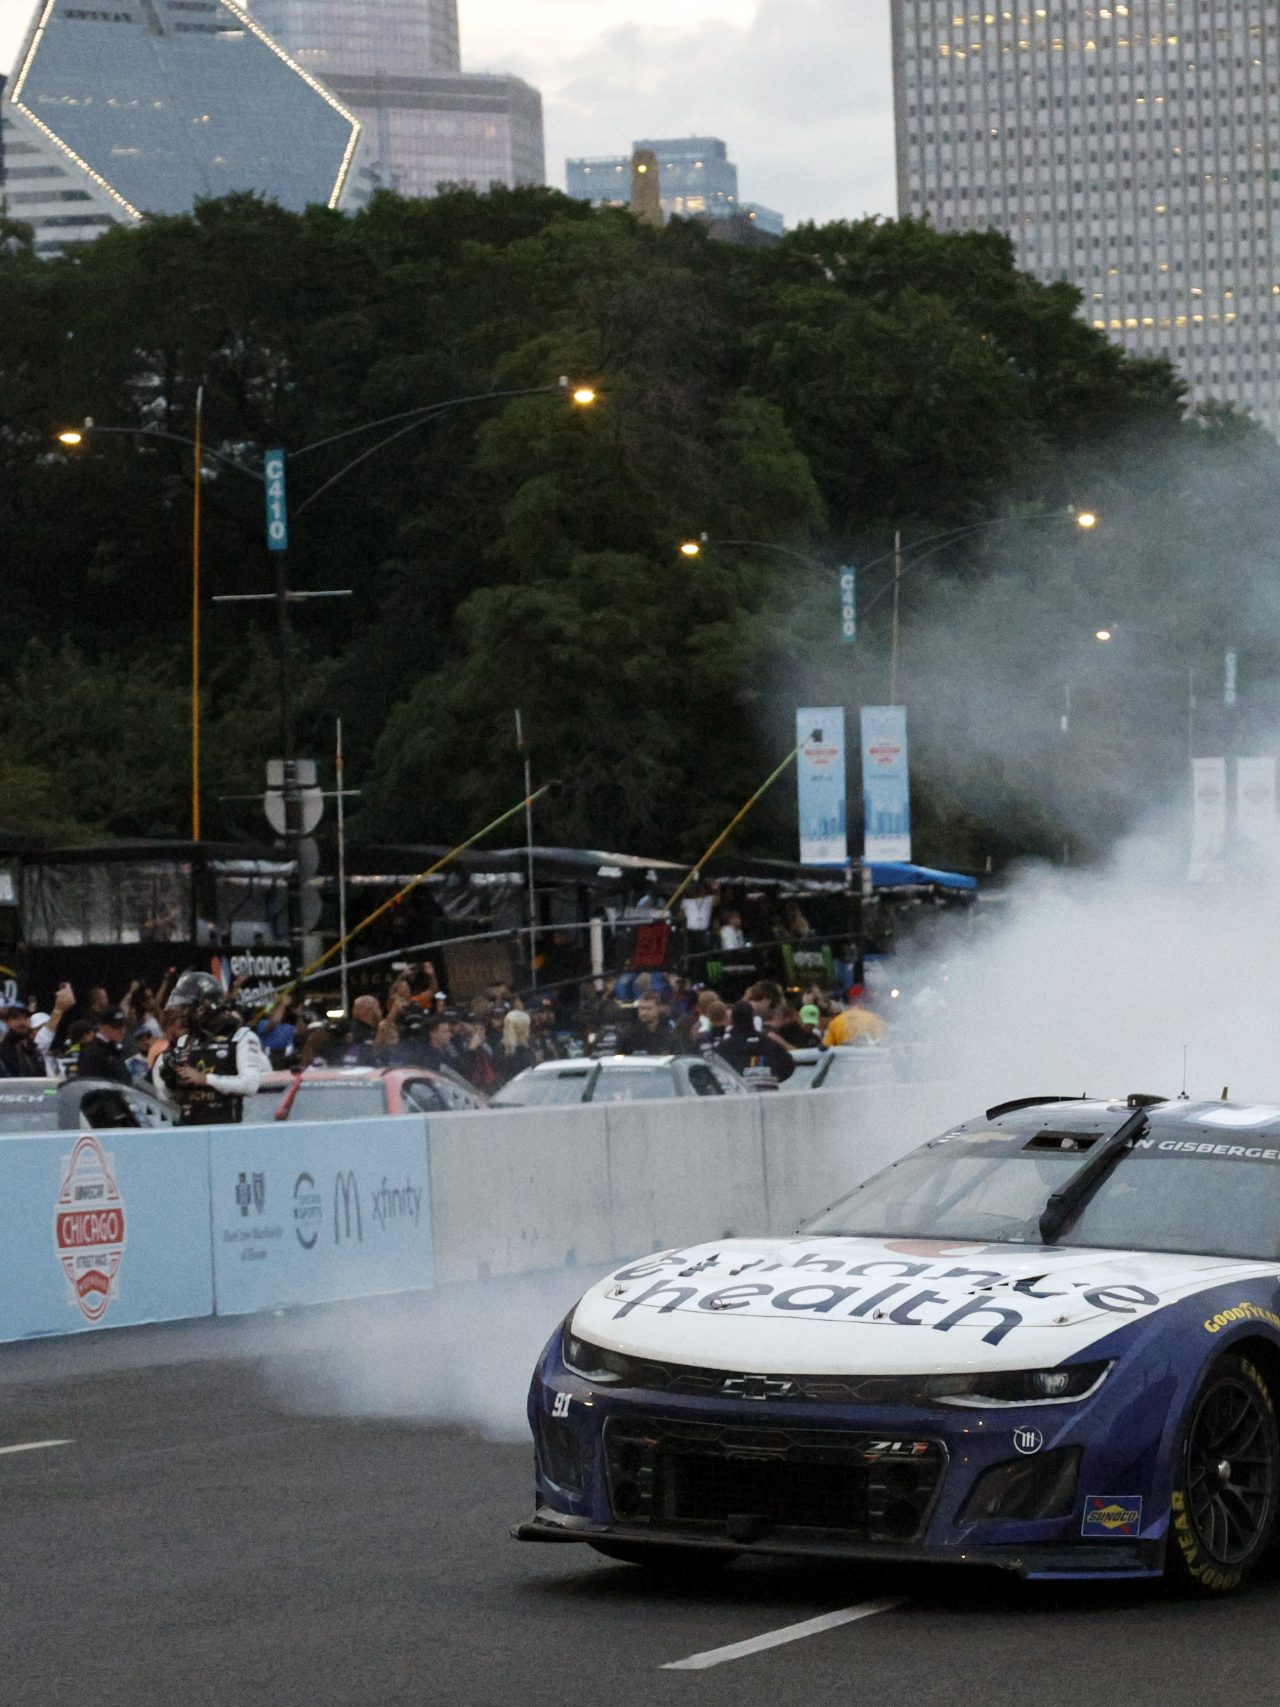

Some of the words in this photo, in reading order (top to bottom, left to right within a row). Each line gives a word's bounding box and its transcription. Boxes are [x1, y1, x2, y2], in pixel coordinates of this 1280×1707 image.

[266, 461, 284, 539] C410
[230, 949, 291, 976] enhance
[371, 1177, 423, 1230] xfinity
[62, 1212, 119, 1244] CHICAGO
[612, 1279, 1023, 1347] health
[552, 1392, 573, 1418] 91
[1089, 1511, 1138, 1522] SUNOCO
